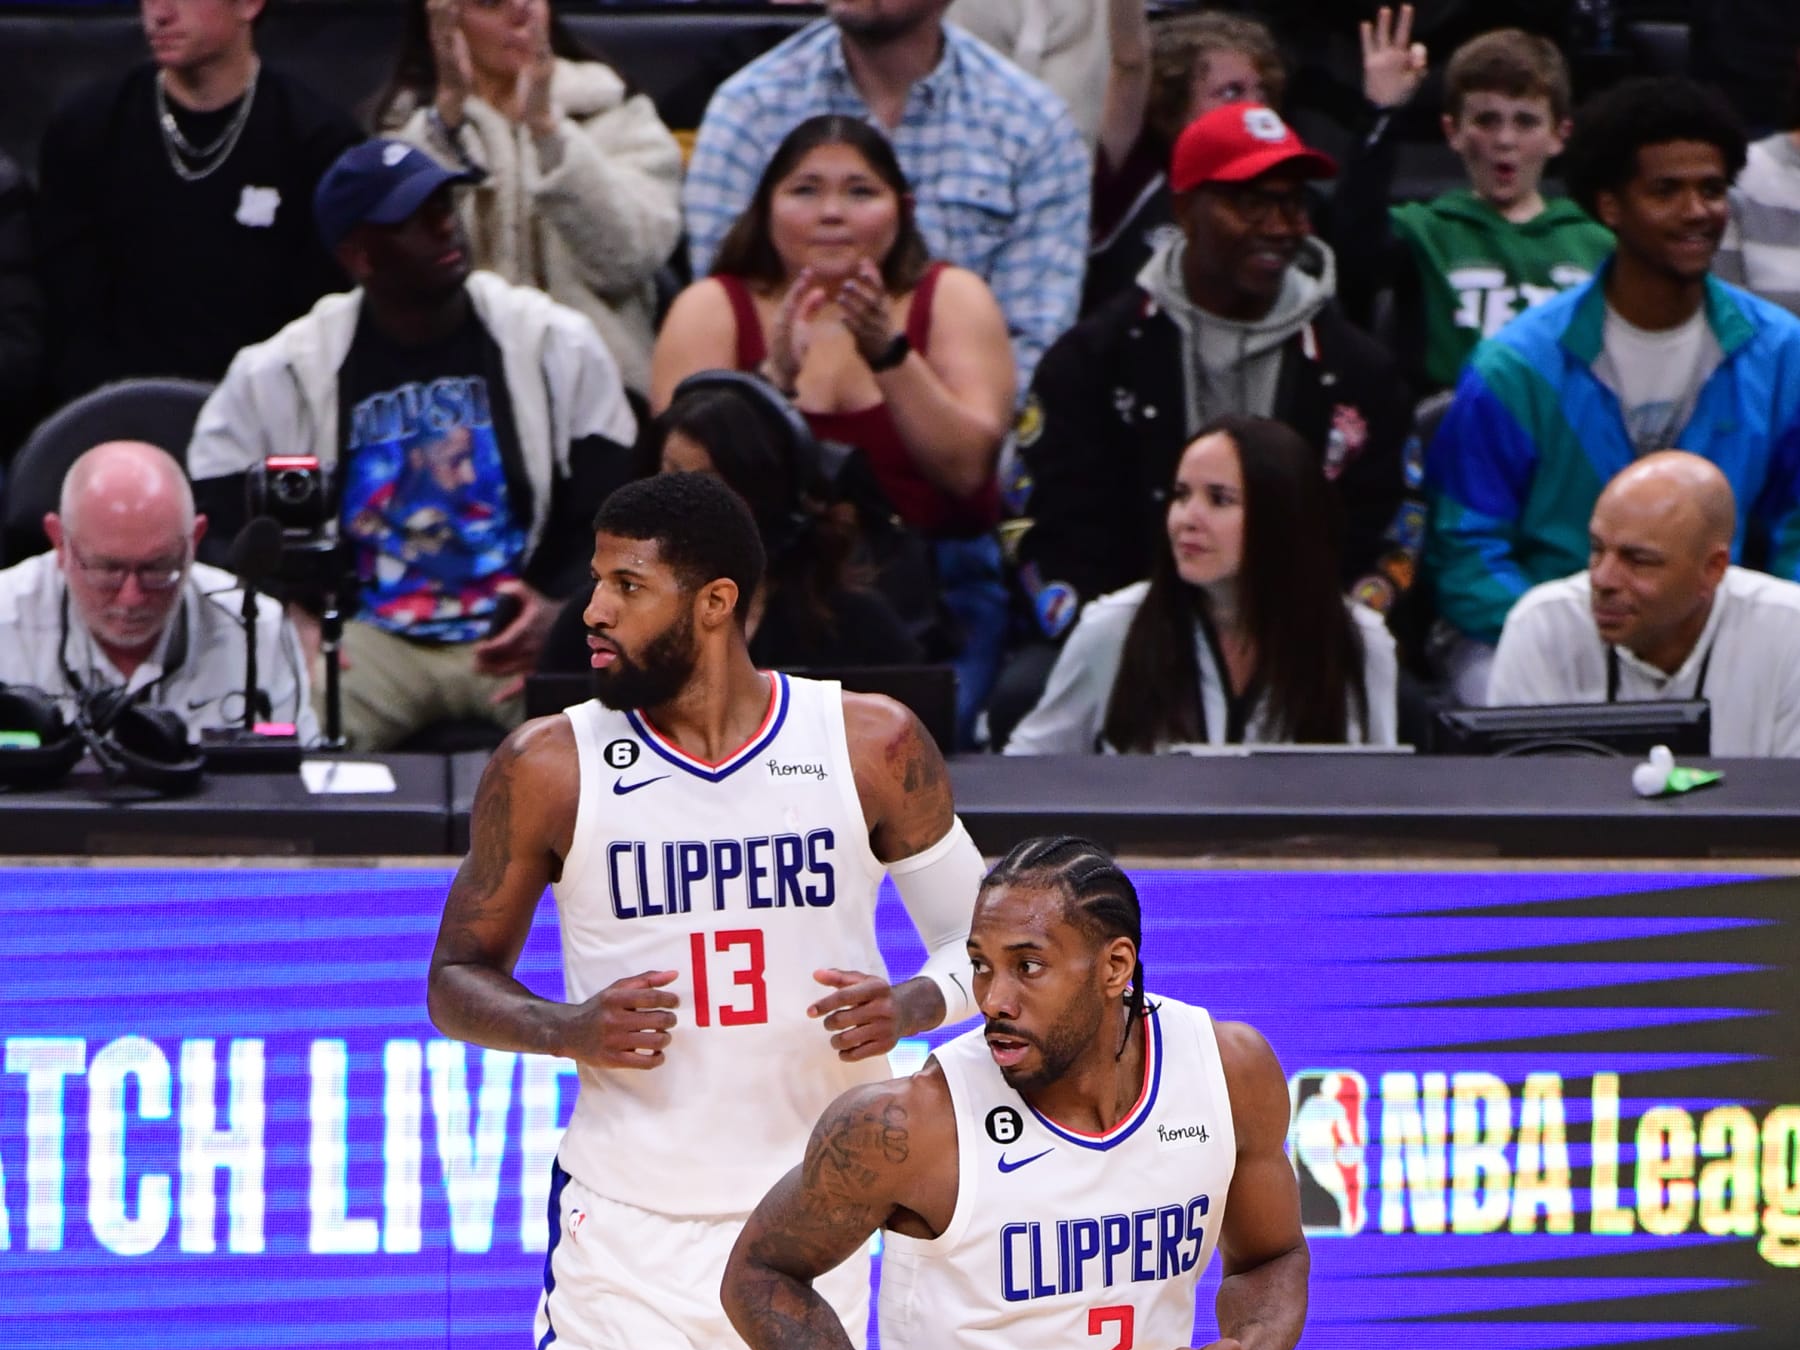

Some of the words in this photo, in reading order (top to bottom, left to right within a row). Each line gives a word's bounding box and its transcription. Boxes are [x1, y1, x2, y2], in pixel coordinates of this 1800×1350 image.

[612, 742, 632, 767] 6
[765, 759, 828, 781] honey
[606, 827, 836, 920] CLIPPERS
[690, 928, 768, 1027] 13
[0, 1034, 266, 1256] TCH
[993, 1111, 1015, 1141] 6
[1157, 1124, 1210, 1143] honey
[1379, 1072, 1576, 1236] NBA
[1000, 1194, 1210, 1302] CLIPPERS
